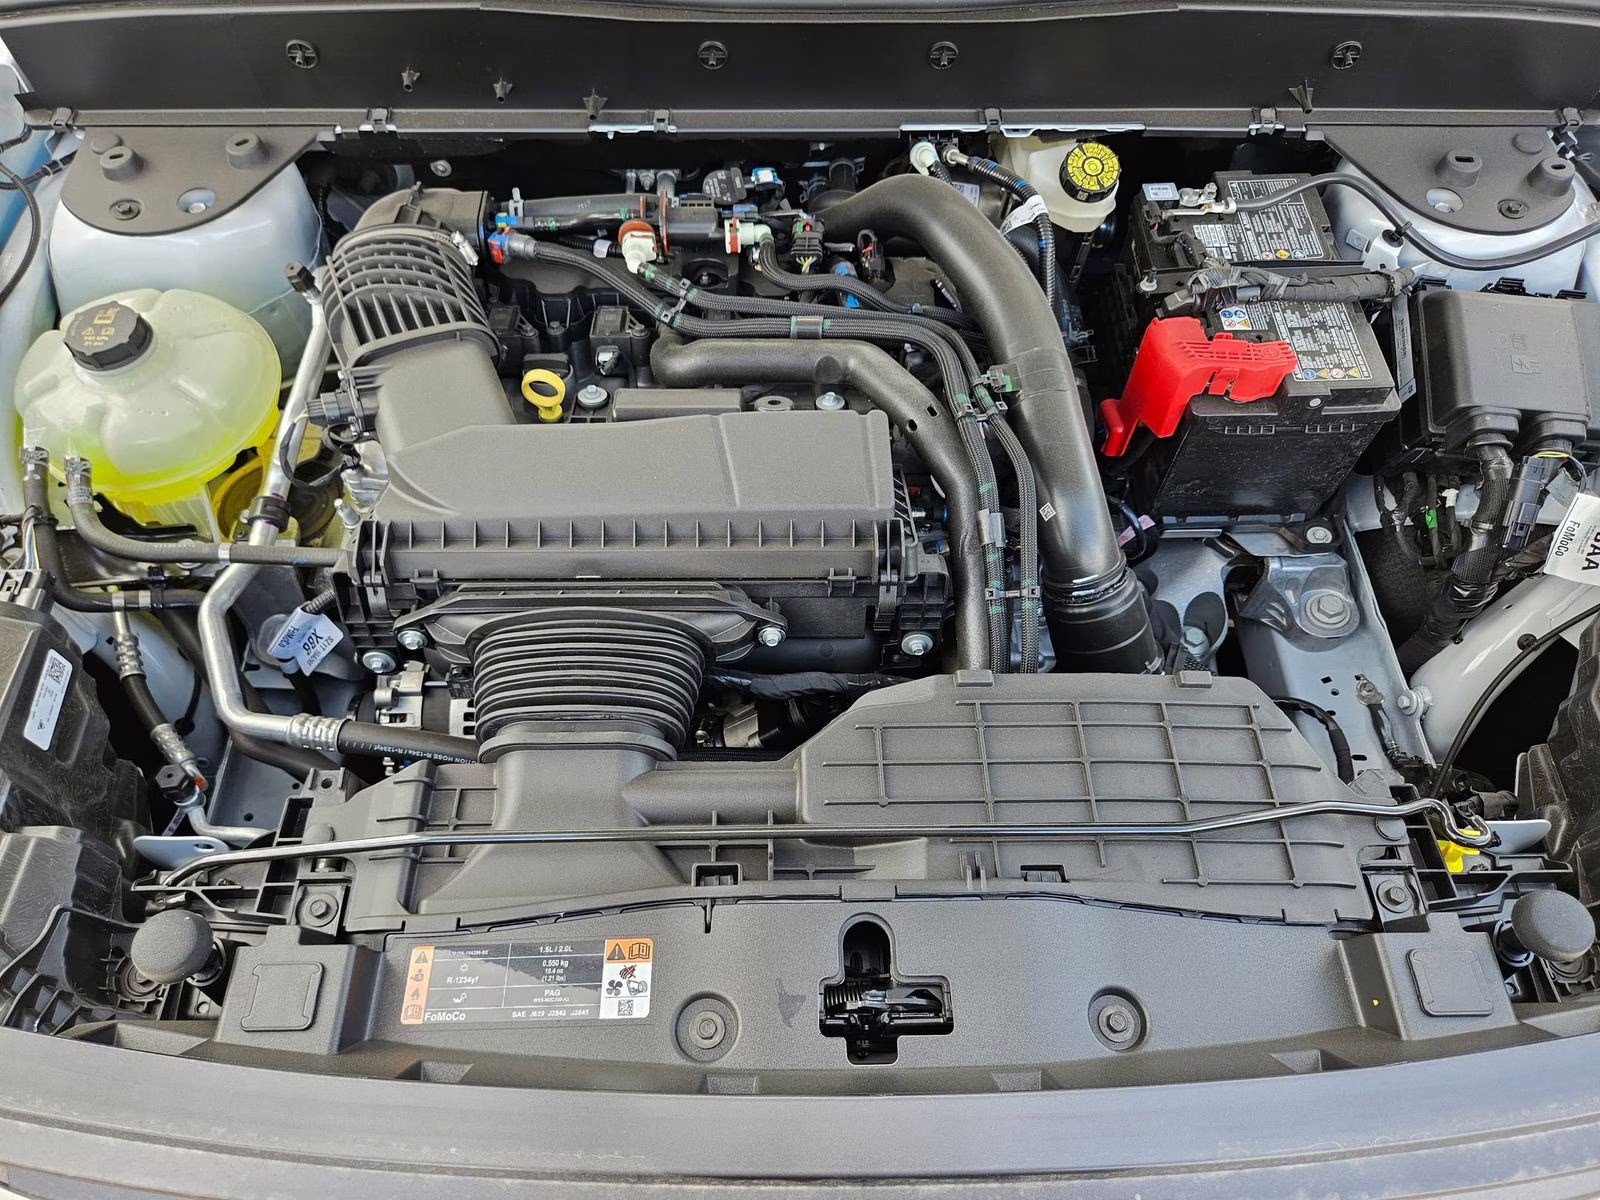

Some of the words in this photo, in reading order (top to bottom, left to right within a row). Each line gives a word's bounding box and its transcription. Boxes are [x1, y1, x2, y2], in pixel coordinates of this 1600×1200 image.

[1555, 520, 1580, 556] FoMoCo
[278, 625, 300, 648] FoMoCo
[433, 753, 453, 762] HOSE
[542, 959, 560, 967] 0.550
[560, 959, 569, 968] kg
[446, 976, 479, 984] R-1234yf
[544, 989, 561, 997] PAG
[424, 1011, 466, 1022] FoMoCo
[511, 1010, 527, 1018] SAE
